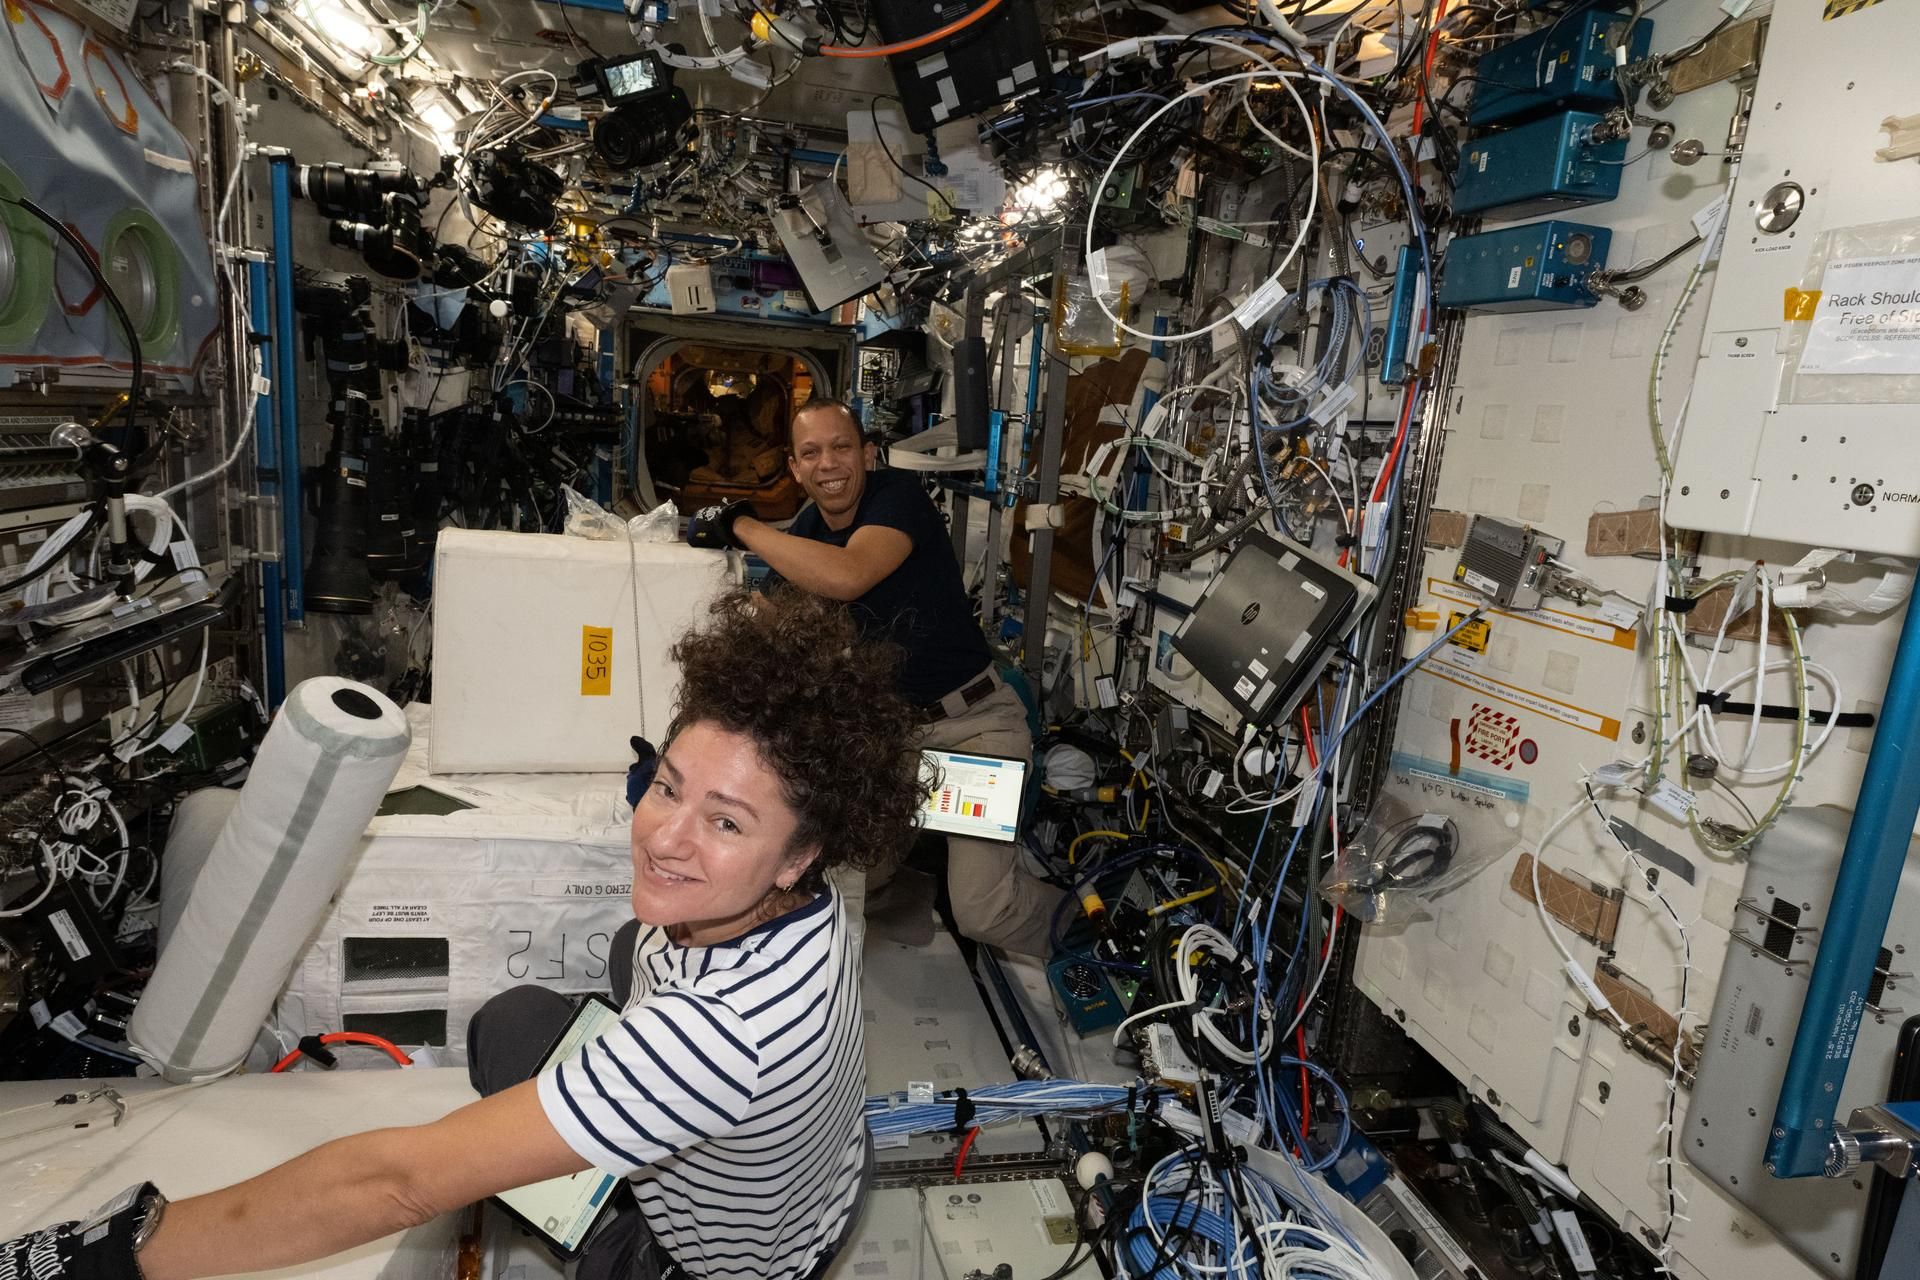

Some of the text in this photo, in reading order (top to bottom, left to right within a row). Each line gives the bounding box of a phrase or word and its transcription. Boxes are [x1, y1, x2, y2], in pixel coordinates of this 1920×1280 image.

[1828, 293, 1865, 307] Rack
[1840, 312, 1875, 325] Free
[1879, 310, 1895, 324] of
[586, 634, 608, 680] 1035
[1477, 728, 1490, 737] FIRE
[1490, 733, 1505, 743] PORT
[564, 882, 632, 895] ZERO G ONLY
[507, 930, 617, 980] SF2
[1832, 1002, 1846, 1037] Handrail
